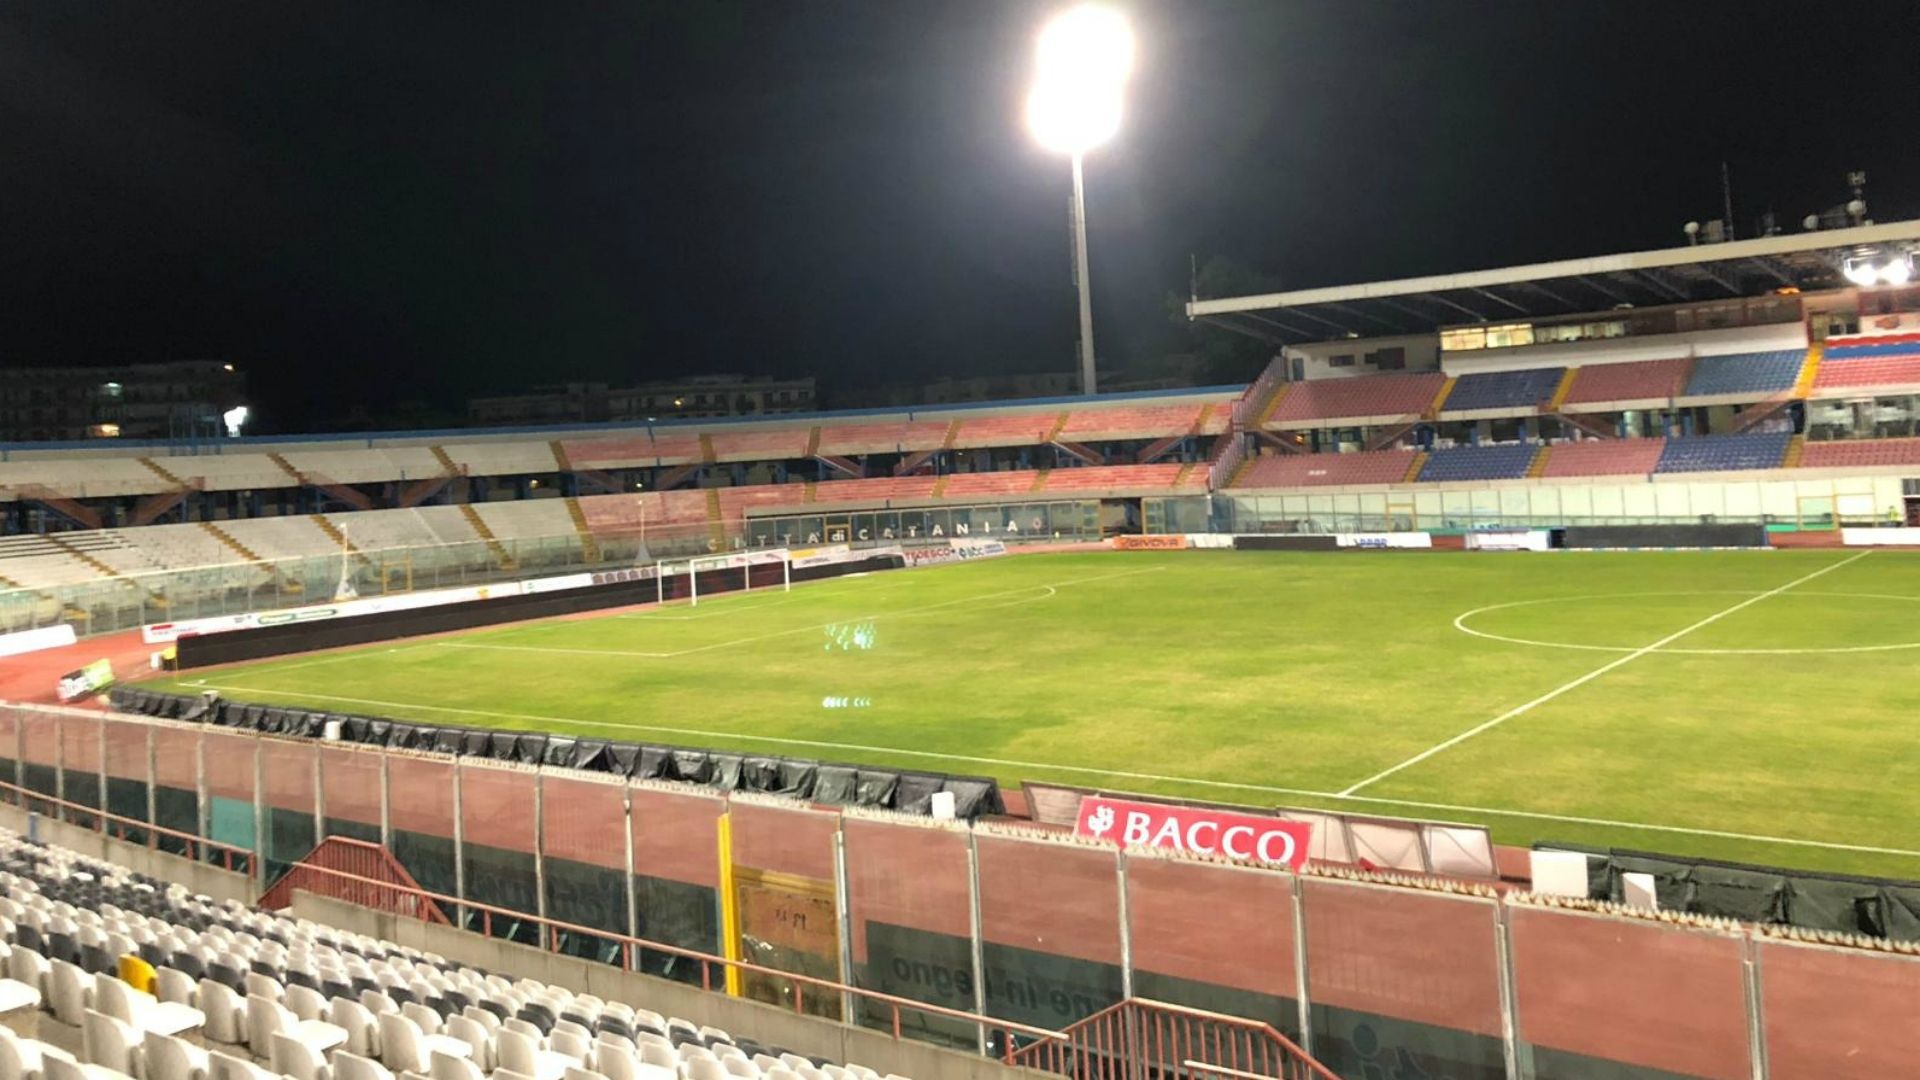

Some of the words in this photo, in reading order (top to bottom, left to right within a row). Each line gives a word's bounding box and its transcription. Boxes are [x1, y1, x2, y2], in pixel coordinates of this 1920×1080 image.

[832, 529, 844, 542] di
[858, 520, 1018, 541] CATANIA
[1124, 811, 1296, 864] BACCO
